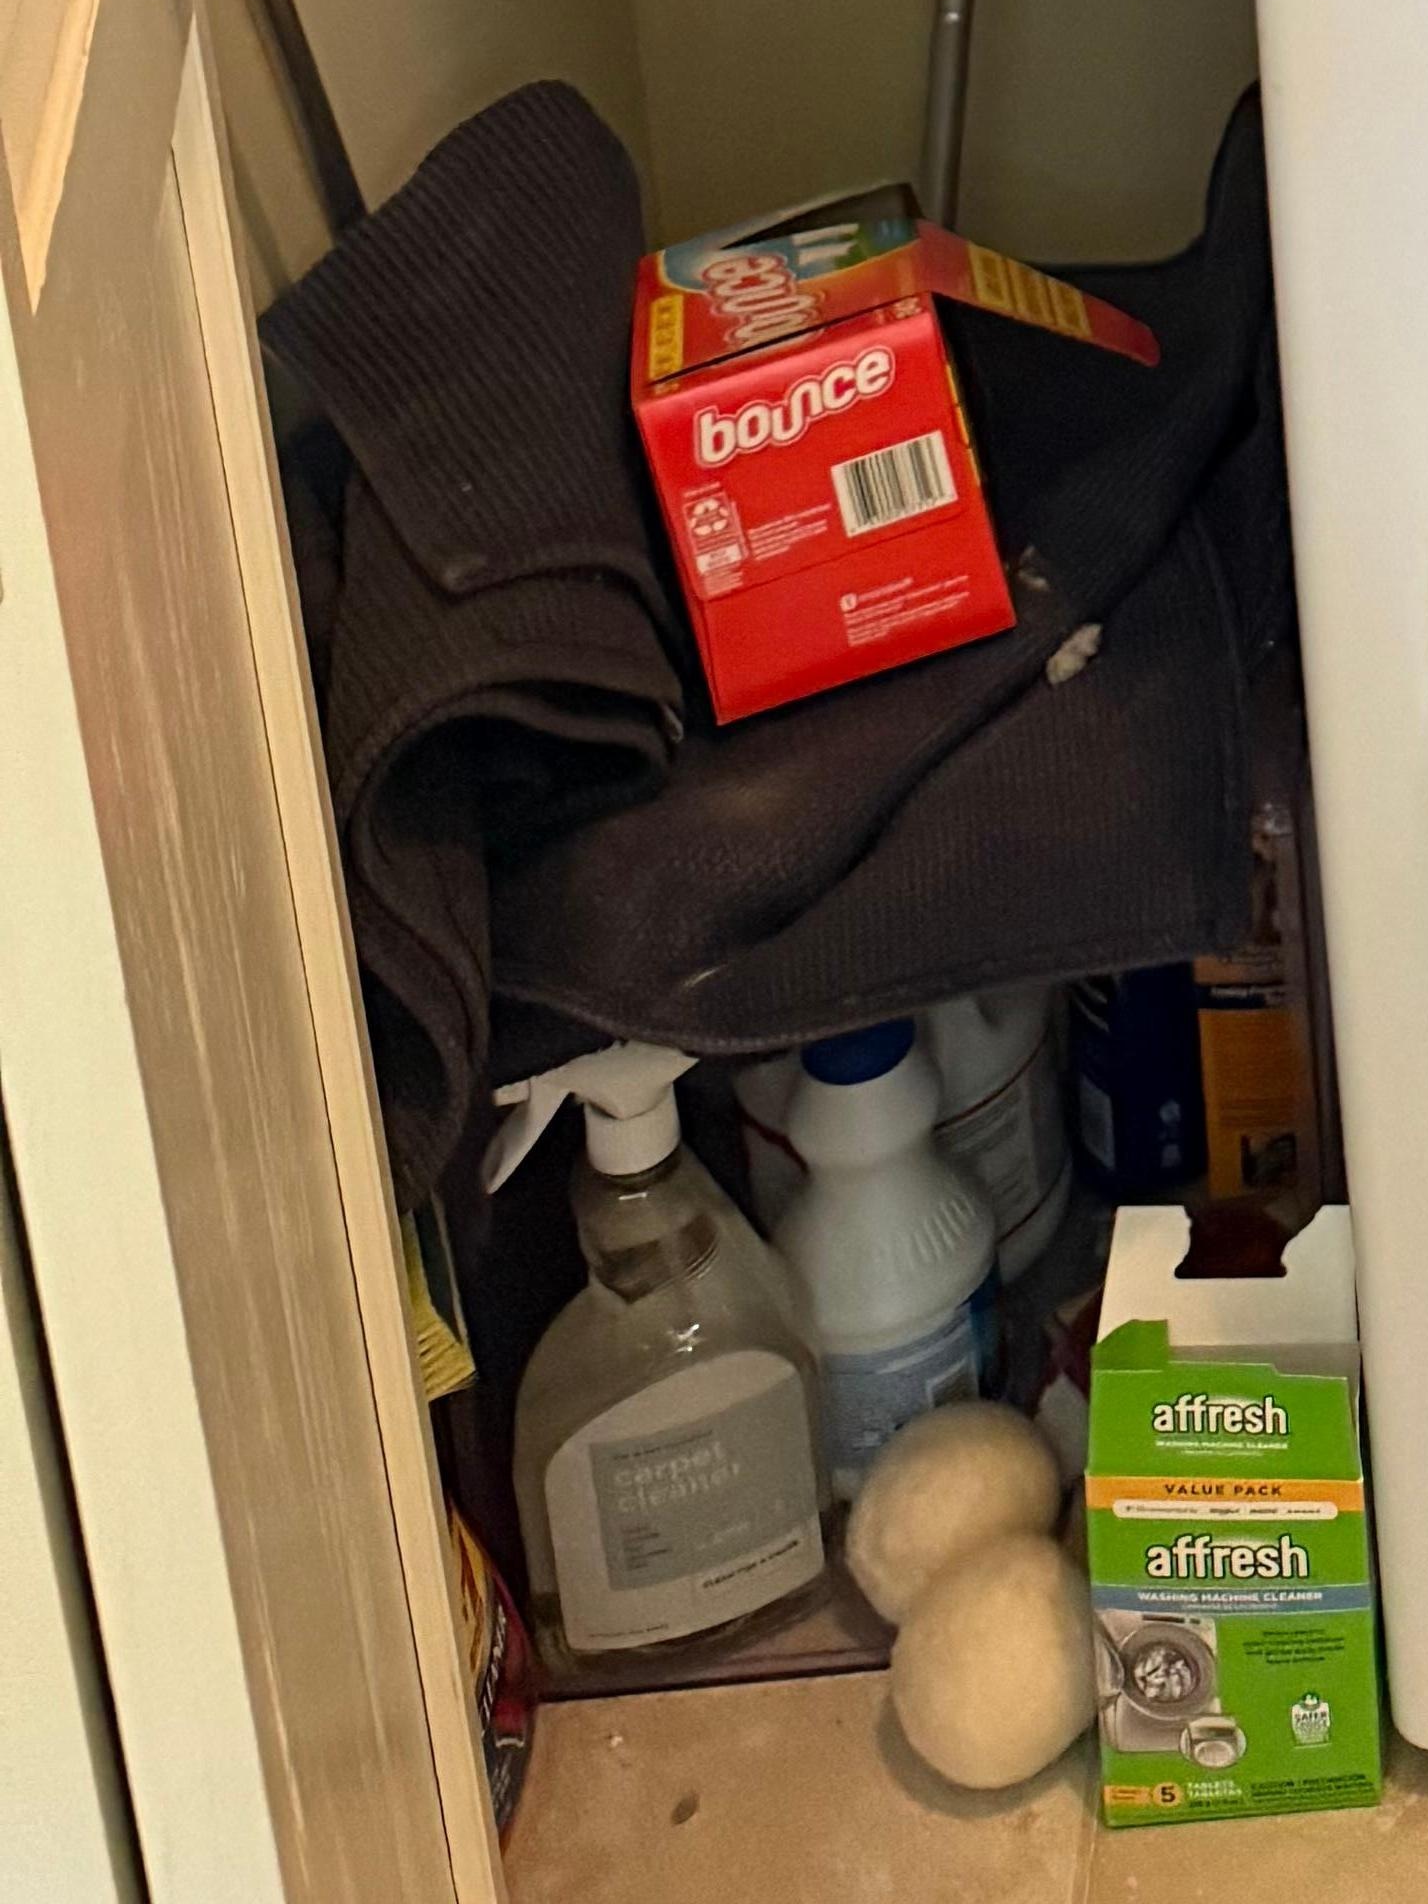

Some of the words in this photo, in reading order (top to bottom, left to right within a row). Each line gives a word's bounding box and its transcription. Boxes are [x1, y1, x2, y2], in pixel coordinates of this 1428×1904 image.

[706, 254, 817, 348] ounce
[696, 346, 895, 469] bounce
[1153, 1394, 1289, 1434] affresh
[1165, 1484, 1225, 1496] VALUE
[1234, 1484, 1282, 1496] PACK
[1147, 1534, 1309, 1578] affresh
[1159, 1785, 1177, 1804] 5
